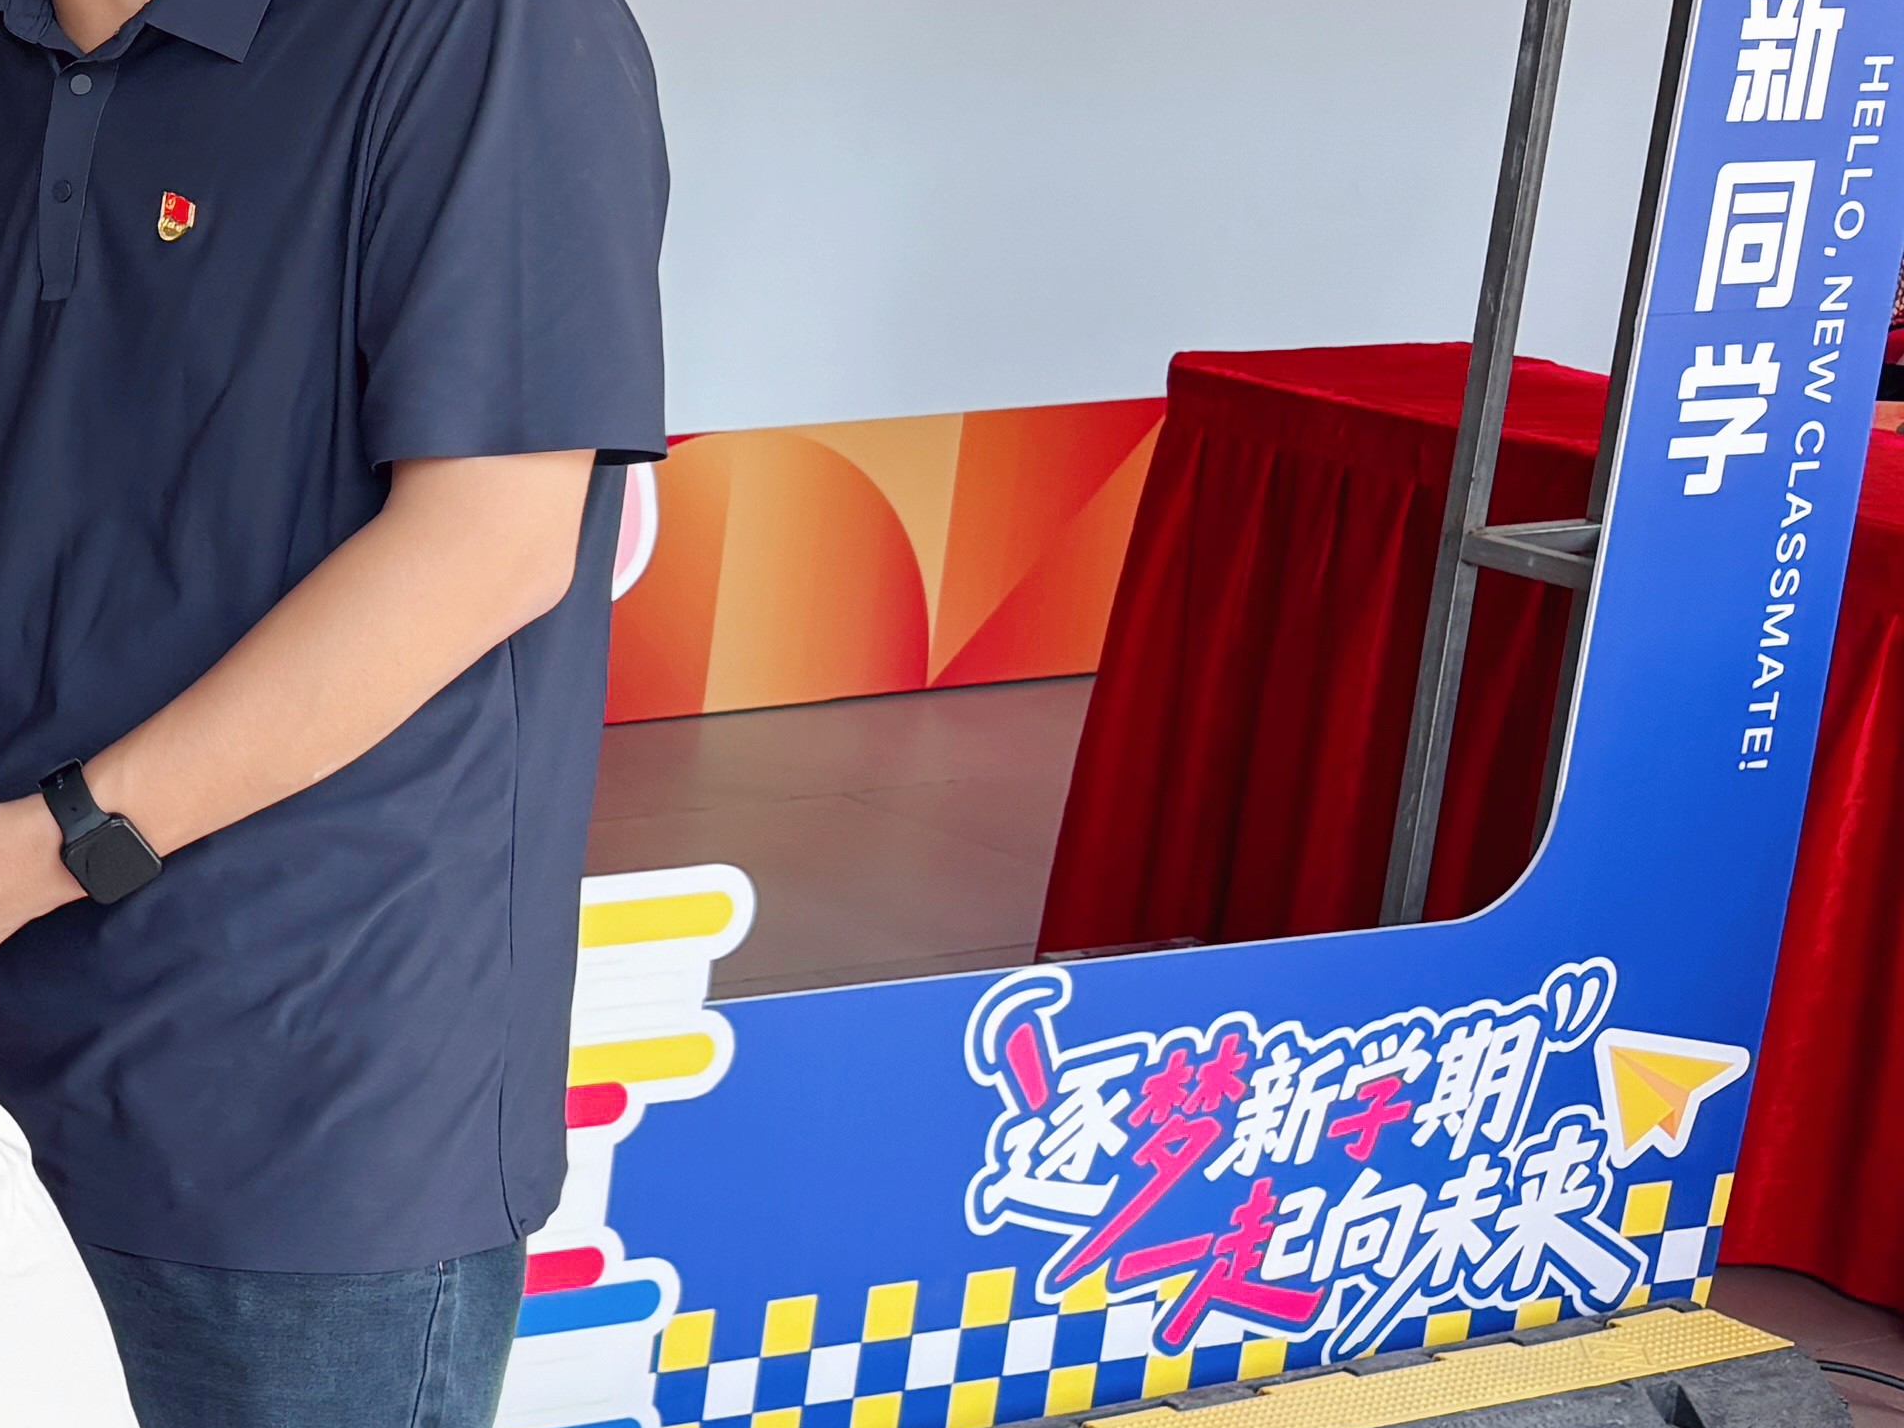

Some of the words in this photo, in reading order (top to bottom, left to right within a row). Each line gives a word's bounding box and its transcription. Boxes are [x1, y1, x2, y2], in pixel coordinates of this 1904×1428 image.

[1823, 55, 1894, 258] HELLO,
[1804, 274, 1853, 403] NEW
[1736, 421, 1825, 773] CLASSMATE!
